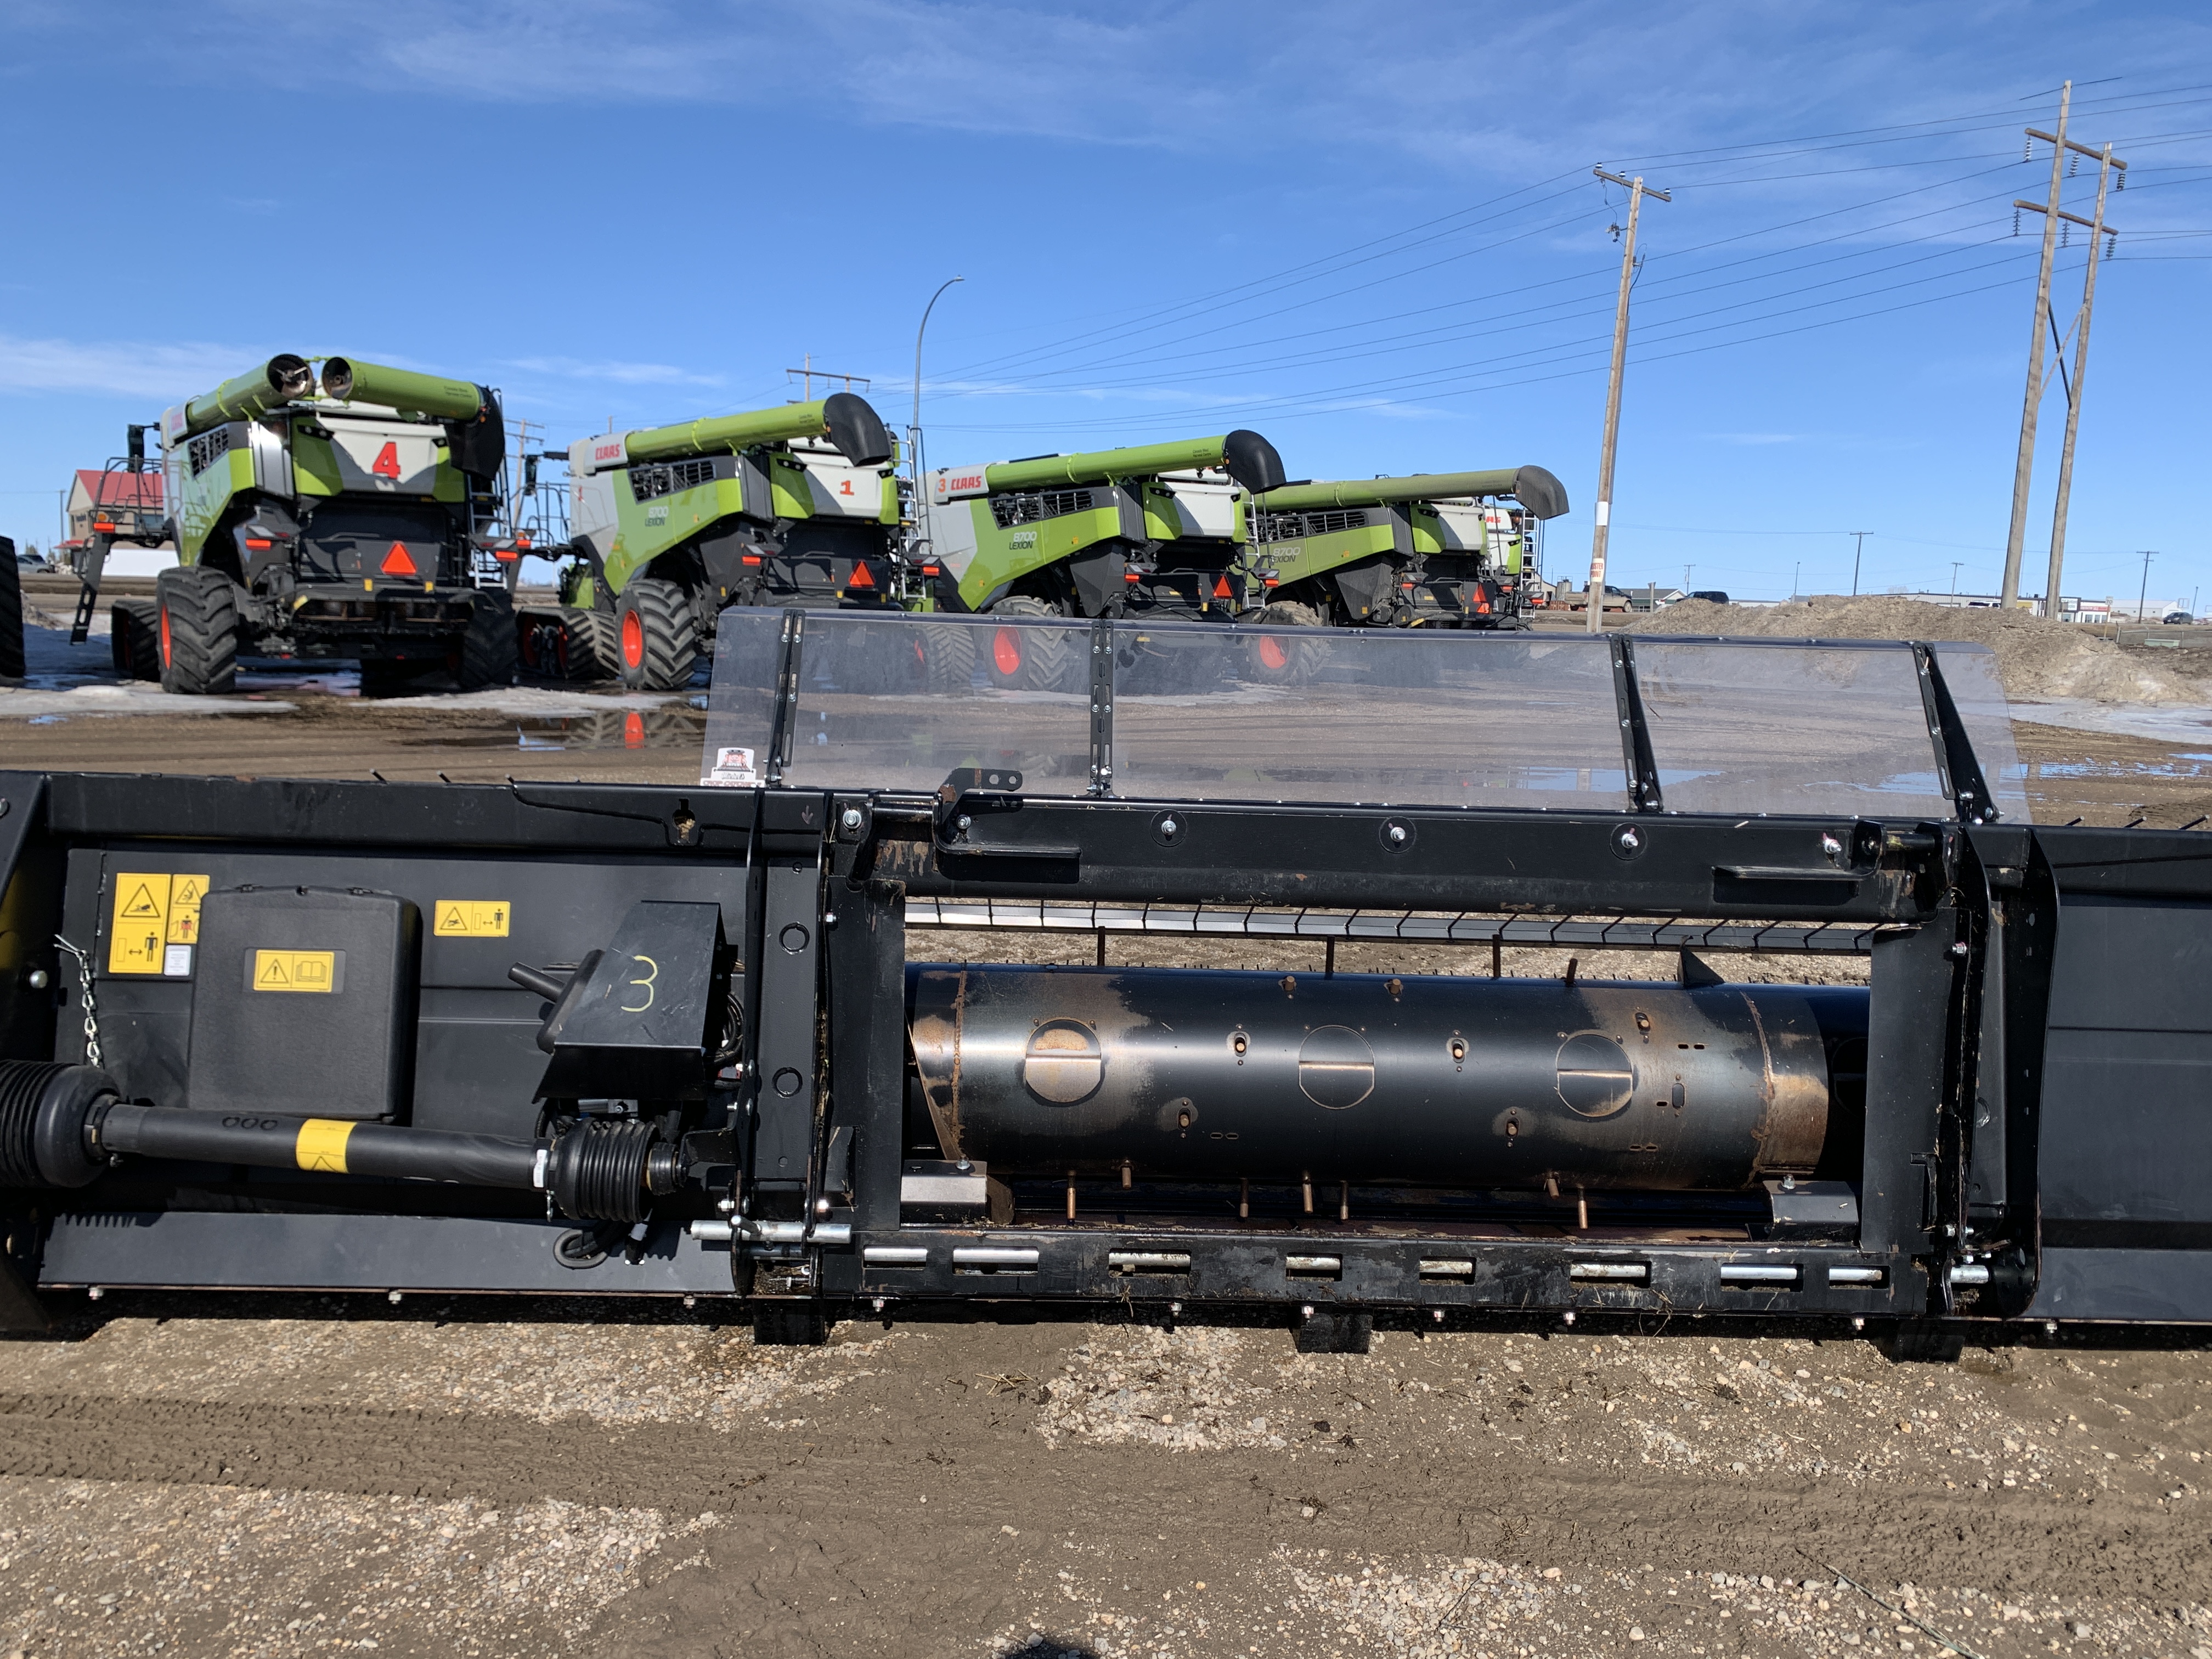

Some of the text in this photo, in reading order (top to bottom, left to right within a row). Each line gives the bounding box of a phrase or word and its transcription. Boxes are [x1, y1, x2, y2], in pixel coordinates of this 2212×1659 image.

[373, 442, 401, 479] 4
[595, 444, 620, 461] CLAAS
[840, 480, 855, 496] 1
[938, 476, 981, 492] 3 CLAAS
[1013, 531, 1037, 542] 8700
[1009, 541, 1033, 550] LEXION
[1273, 547, 1301, 556] 8700
[621, 955, 658, 1012] 3
